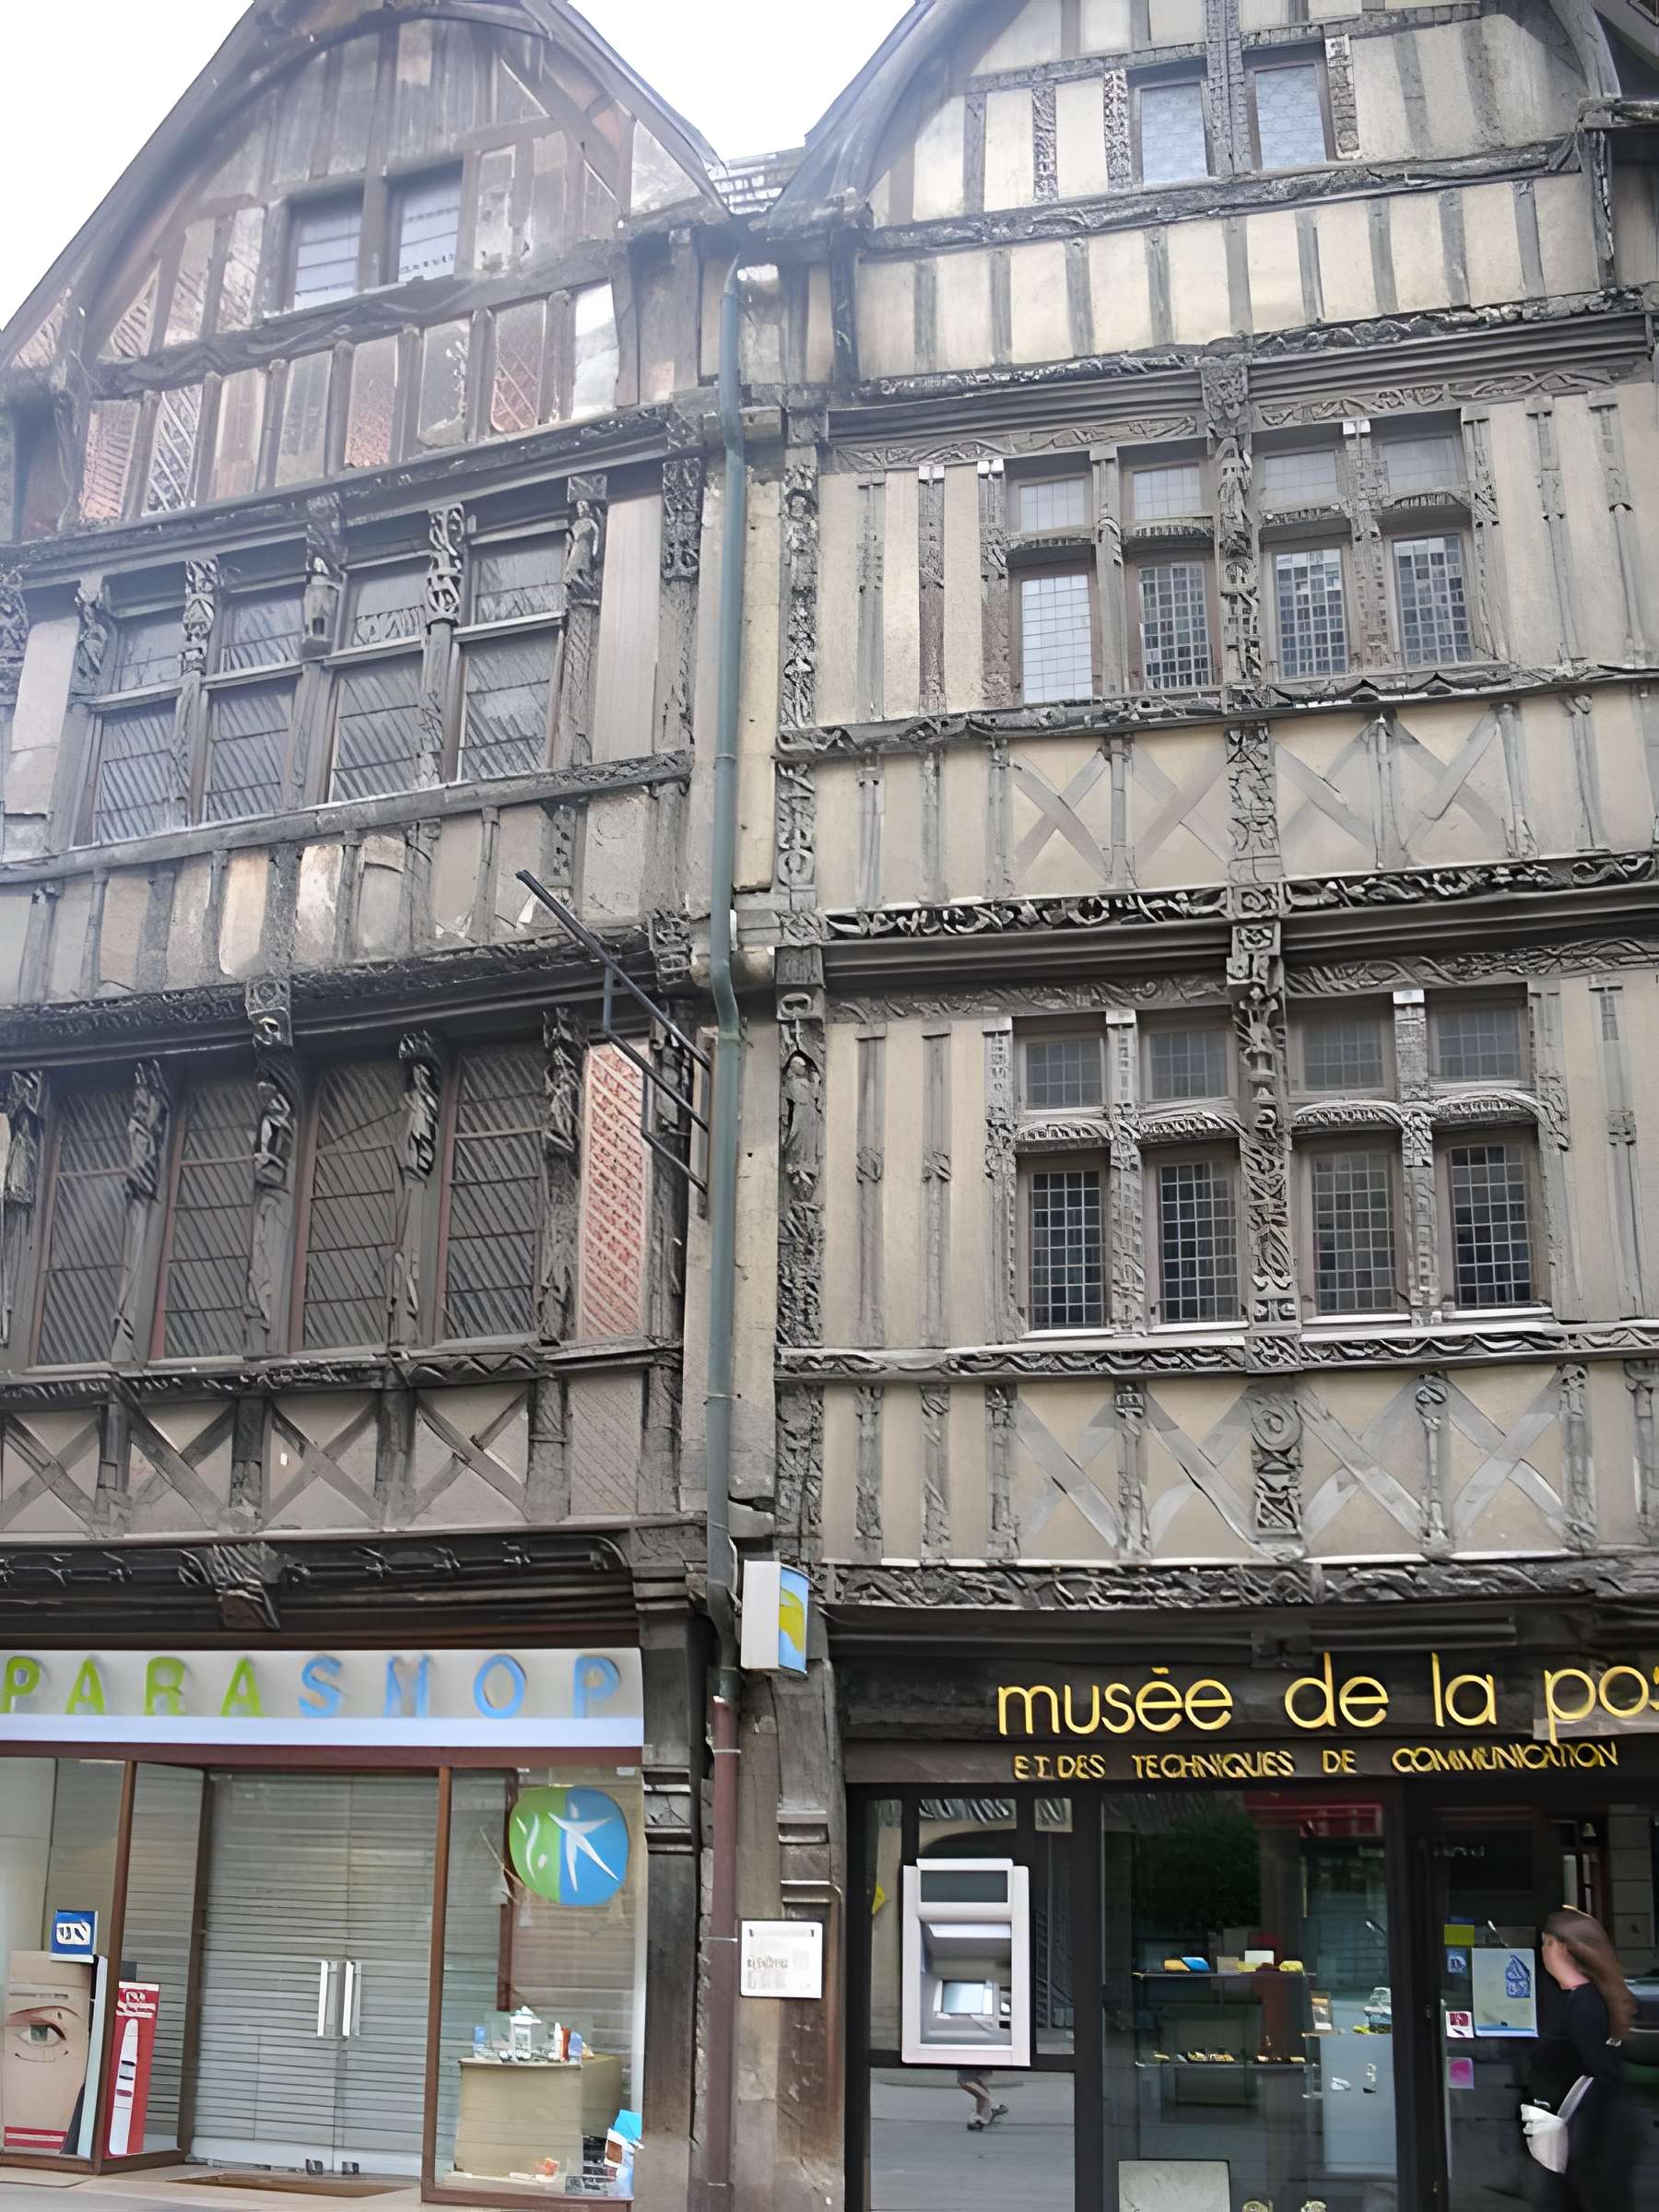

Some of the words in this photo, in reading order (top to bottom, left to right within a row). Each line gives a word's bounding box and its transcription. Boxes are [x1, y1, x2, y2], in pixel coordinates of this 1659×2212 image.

[997, 1666, 1233, 1735] musée
[1284, 1651, 1390, 1729] de
[1430, 1651, 1498, 1727] la
[1544, 1665, 1659, 1746] po
[1056, 1753, 1106, 1780] DES
[1131, 1749, 1295, 1780] TECHNIQUES
[1322, 1748, 1358, 1774] DE
